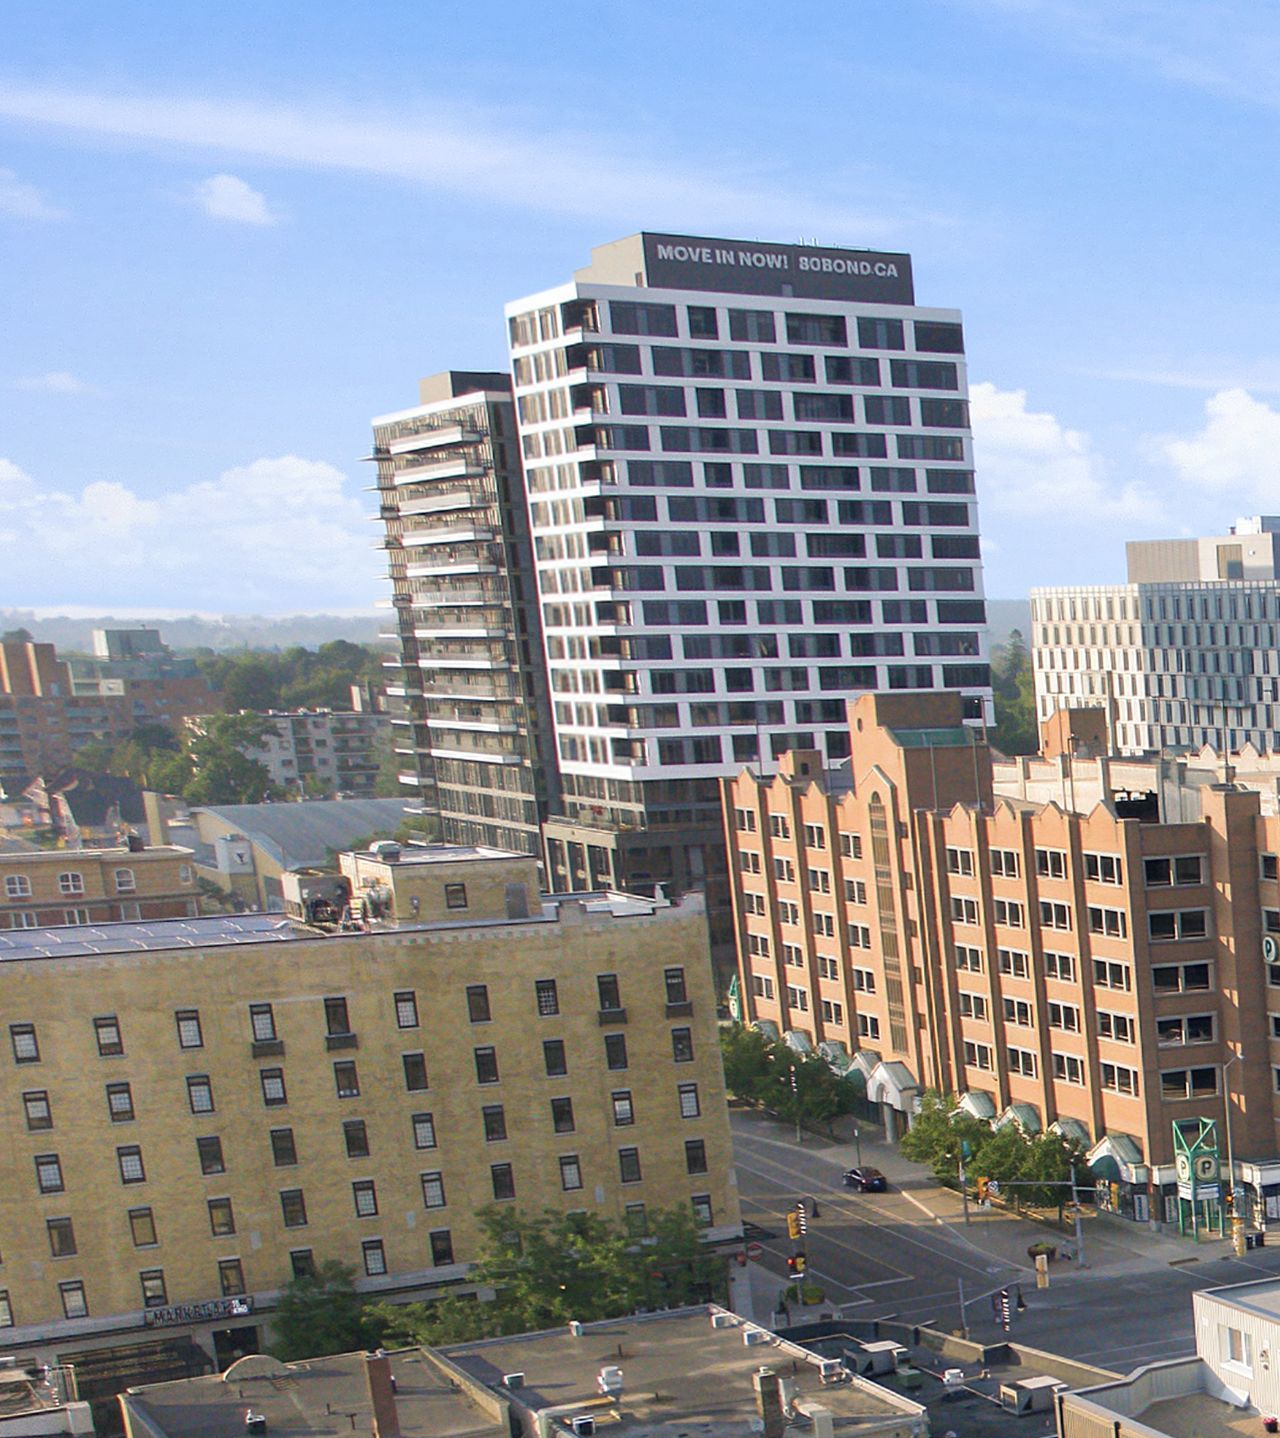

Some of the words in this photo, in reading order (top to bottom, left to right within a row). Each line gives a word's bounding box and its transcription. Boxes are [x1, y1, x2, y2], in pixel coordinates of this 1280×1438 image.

[657, 244, 711, 263] MOVE
[715, 249, 735, 266] IN
[738, 252, 788, 270] NOW!
